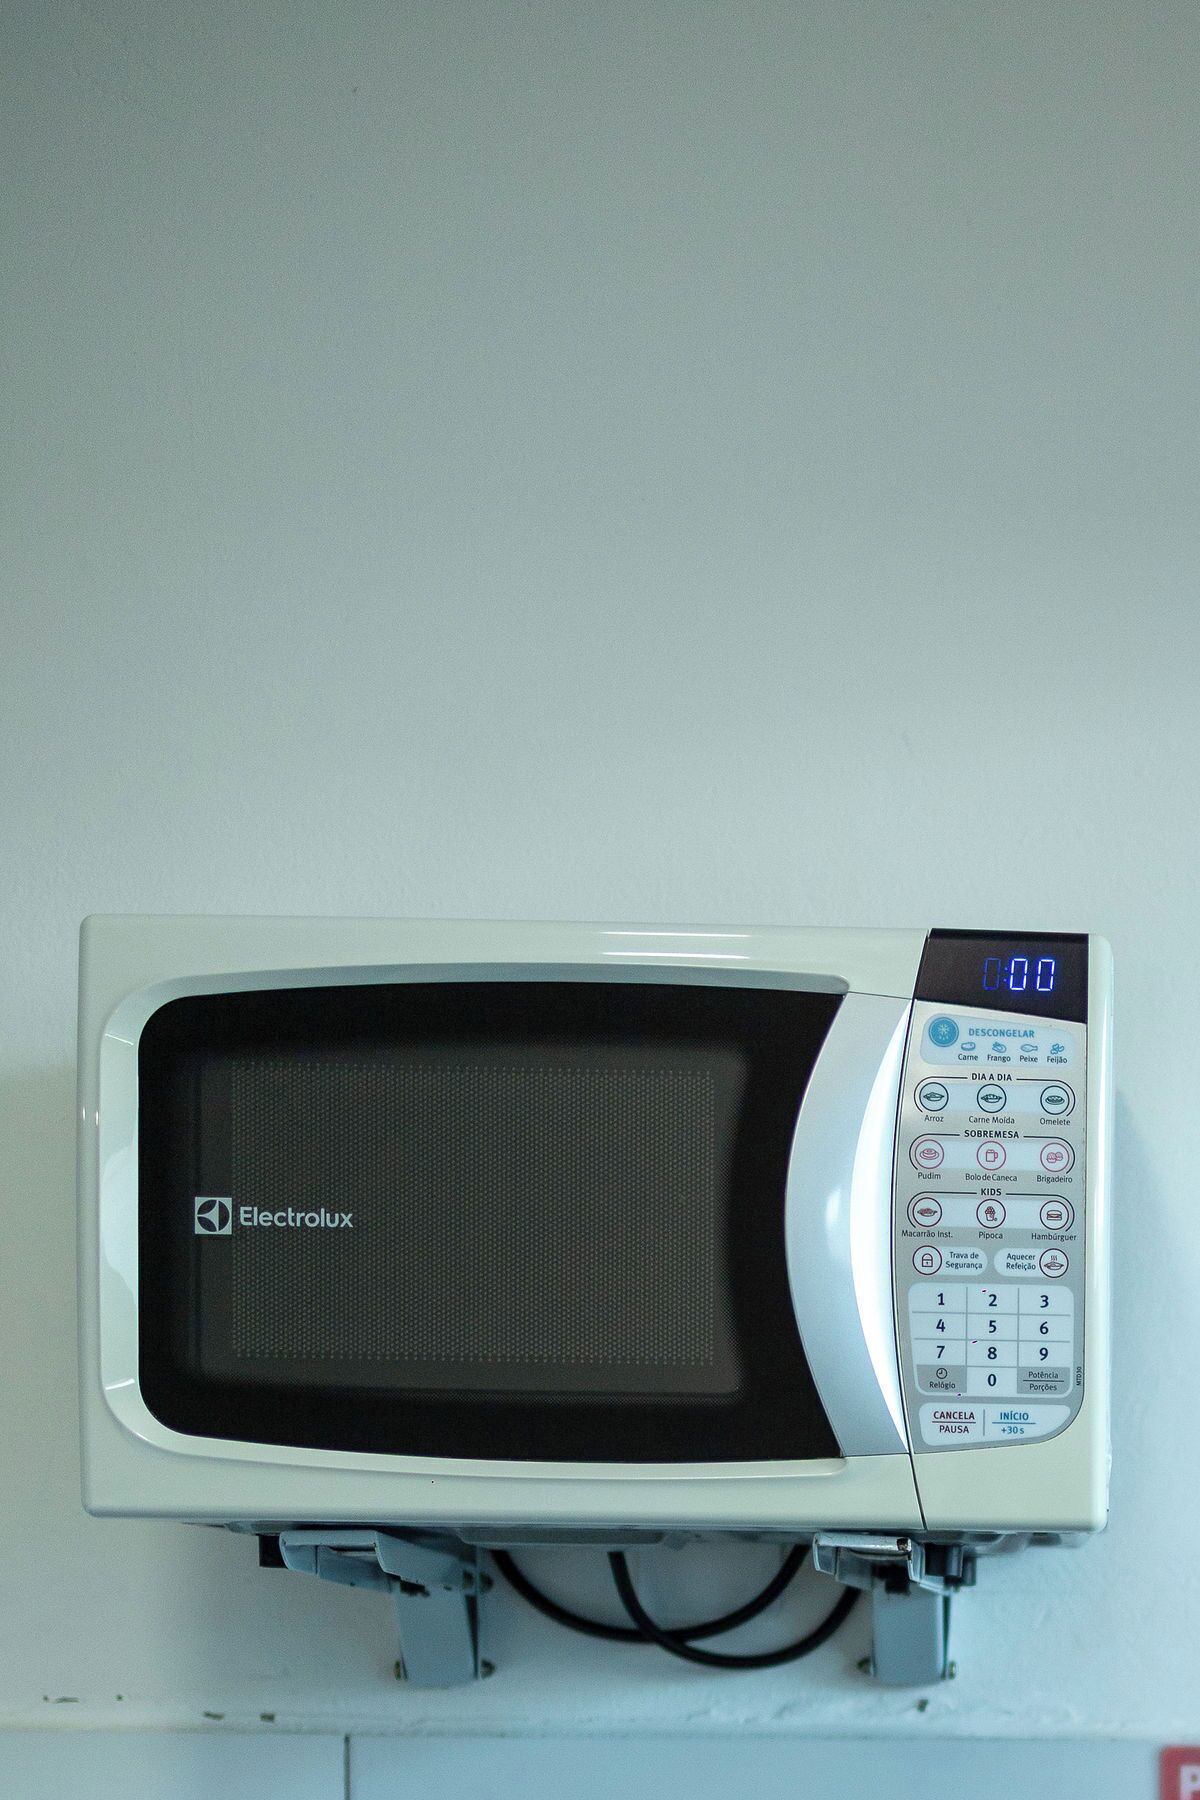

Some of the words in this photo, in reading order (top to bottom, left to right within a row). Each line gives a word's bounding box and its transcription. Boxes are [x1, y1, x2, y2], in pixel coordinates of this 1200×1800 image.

[968, 1028, 1035, 1038] DESCONGELAR
[958, 1053, 979, 1062] Carne
[987, 1054, 1011, 1063] Frango
[1019, 1055, 1038, 1063] Peixe
[1046, 1056, 1068, 1065] Feijão
[971, 1073, 987, 1081] DIA
[988, 1073, 995, 1081] A
[997, 1074, 1012, 1082] DIA
[924, 1115, 944, 1123] Arroz
[968, 1115, 989, 1124] Carne
[992, 1116, 1015, 1125] Moída
[1039, 1118, 1071, 1126] Omelete
[964, 1130, 1019, 1139] SOBREMESA
[917, 1172, 941, 1180] Pudim
[965, 1173, 981, 1181] Bolo
[991, 1174, 1018, 1182] Caneca
[1036, 1175, 1073, 1184] Brigadeiro
[980, 1188, 1002, 1196] KIDS
[239, 1206, 353, 1228] Electrolux
[901, 1230, 936, 1238] Macarrão
[937, 1230, 953, 1239] Inst.
[978, 1231, 1003, 1241] Pipoca
[1031, 1233, 1077, 1242] Hambúrguer
[949, 1251, 968, 1259] Trava
[1006, 1253, 1036, 1262] Aquecer
[945, 1261, 983, 1270] Segurança
[1006, 1262, 1037, 1271] Refeição
[937, 1293, 945, 1306] 1
[988, 1294, 997, 1307] 2
[1039, 1295, 1049, 1308] 3
[936, 1319, 946, 1332] 4
[988, 1320, 997, 1333] 5
[1039, 1321, 1049, 1334] 6
[936, 1345, 945, 1359] 7
[987, 1346, 997, 1360] 8
[1039, 1347, 1049, 1361] 9
[1028, 1371, 1059, 1379] Potência
[987, 1373, 997, 1387] 0
[929, 1381, 956, 1390] Relógio
[1029, 1384, 1057, 1392] Porções
[933, 1411, 975, 1420] CANCELA
[1000, 1411, 1029, 1421] INÍCIO
[939, 1425, 969, 1434] PAUSA
